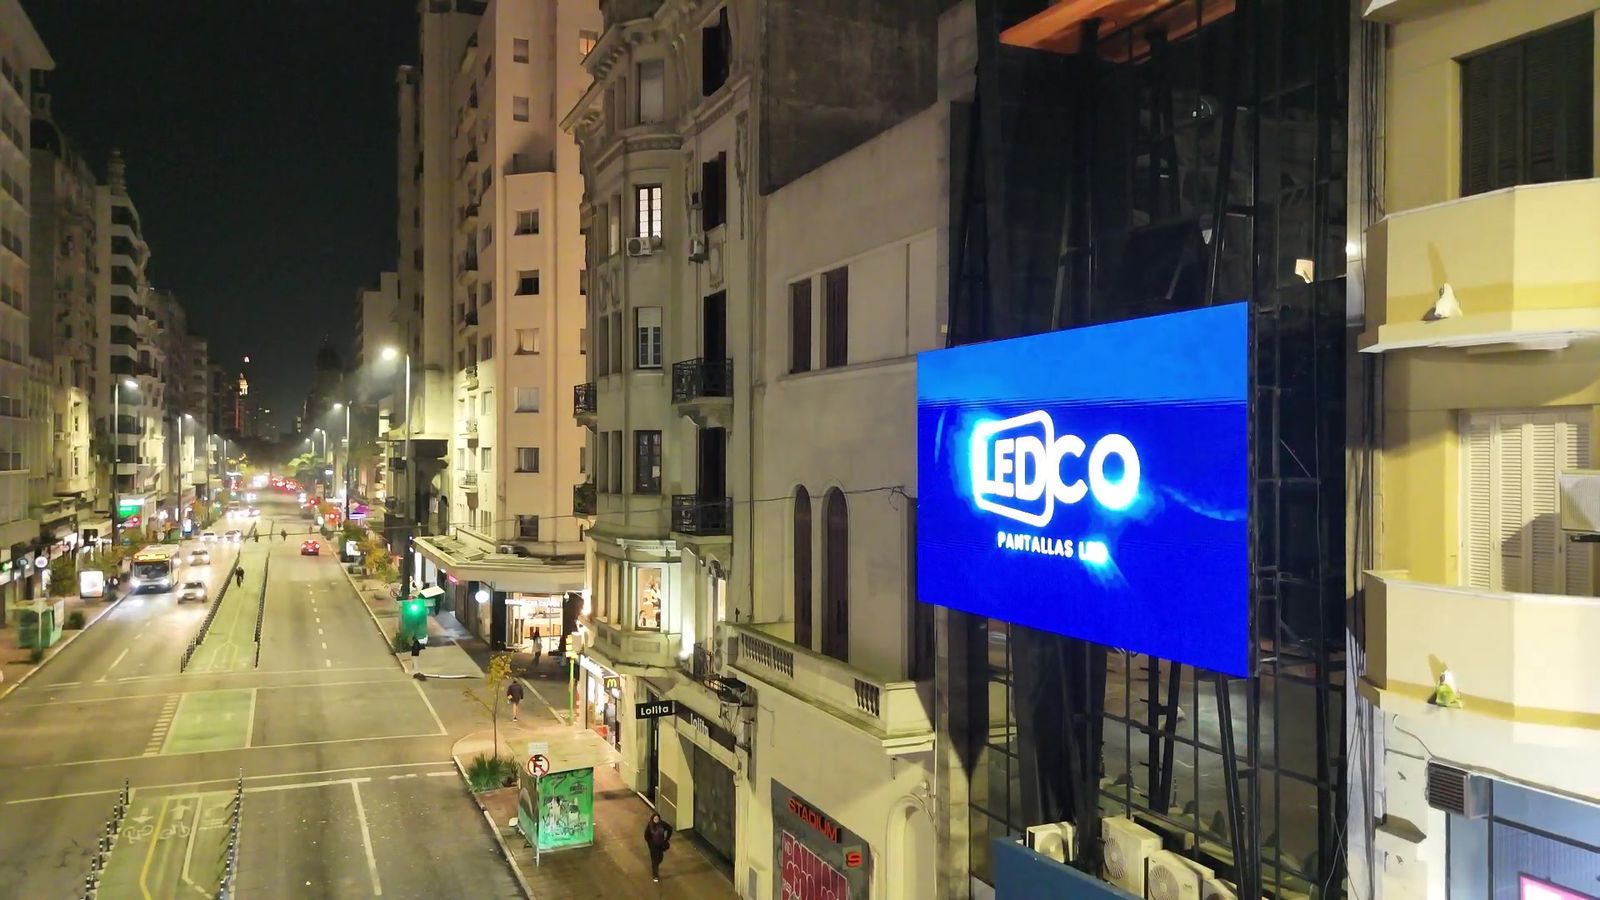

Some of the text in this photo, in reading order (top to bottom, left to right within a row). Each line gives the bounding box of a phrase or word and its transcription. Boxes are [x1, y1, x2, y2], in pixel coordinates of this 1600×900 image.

[972, 433, 1141, 511] LEDCO
[997, 531, 1074, 558] PANTALLAS
[640, 704, 669, 716] Lolita
[788, 797, 838, 843] STADIUM
[846, 851, 862, 868] S
